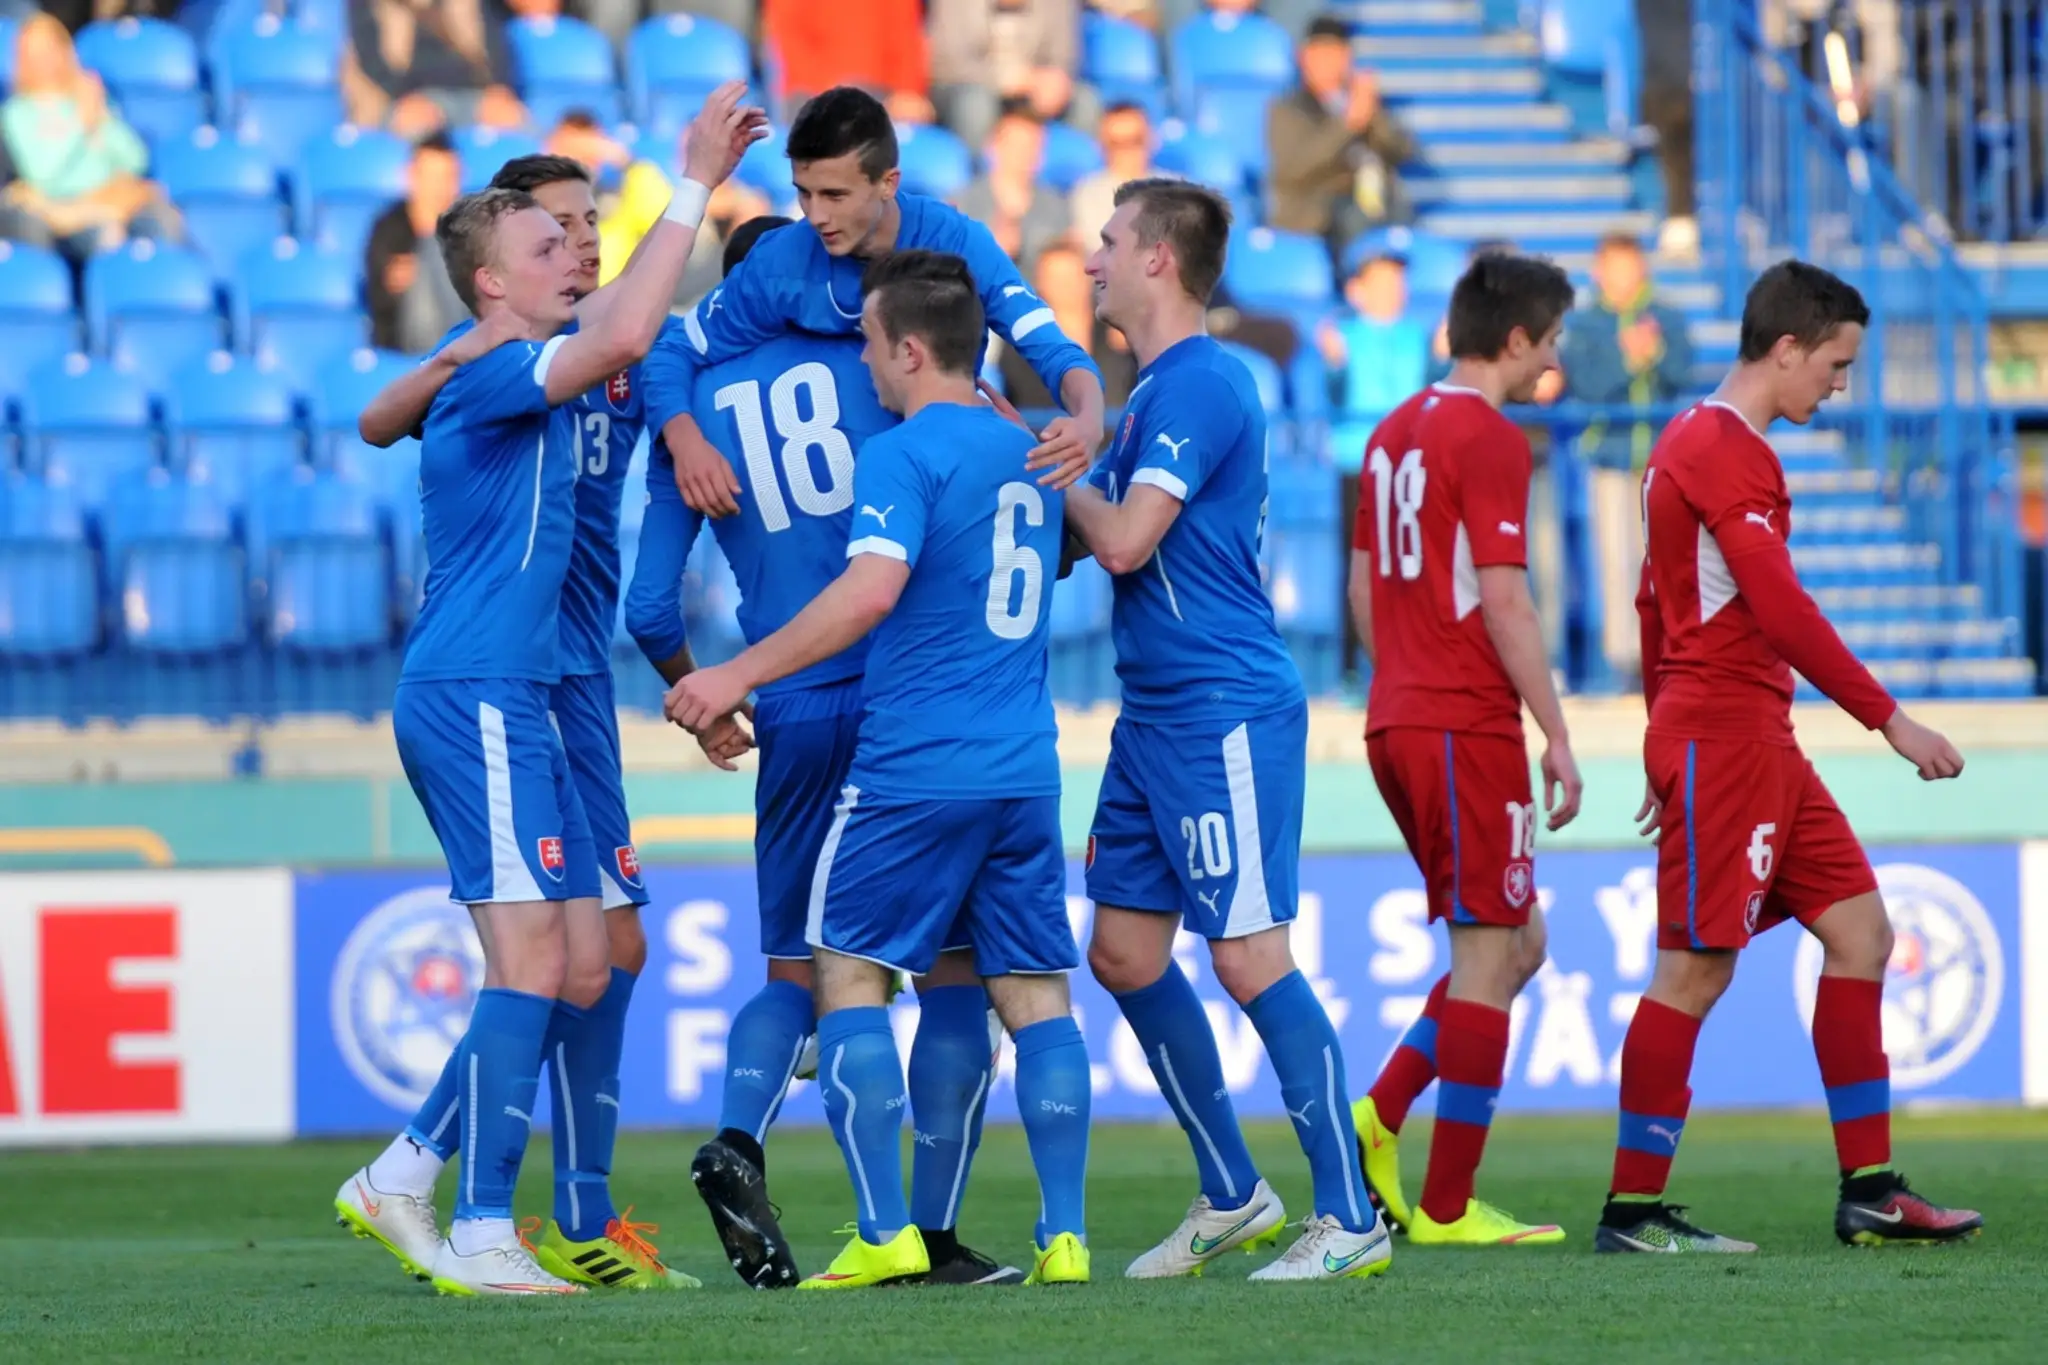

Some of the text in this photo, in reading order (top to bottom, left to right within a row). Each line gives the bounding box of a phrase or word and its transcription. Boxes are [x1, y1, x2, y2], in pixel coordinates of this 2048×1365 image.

[715, 362, 855, 532] 18
[1369, 446, 1426, 580] 18
[986, 482, 1043, 639] 6
[1181, 811, 1232, 879] 20
[1505, 800, 1537, 859] 18
[1746, 822, 1776, 882] 6
[733, 1067, 765, 1079] SVK
[1040, 1099, 1078, 1116] SVK
